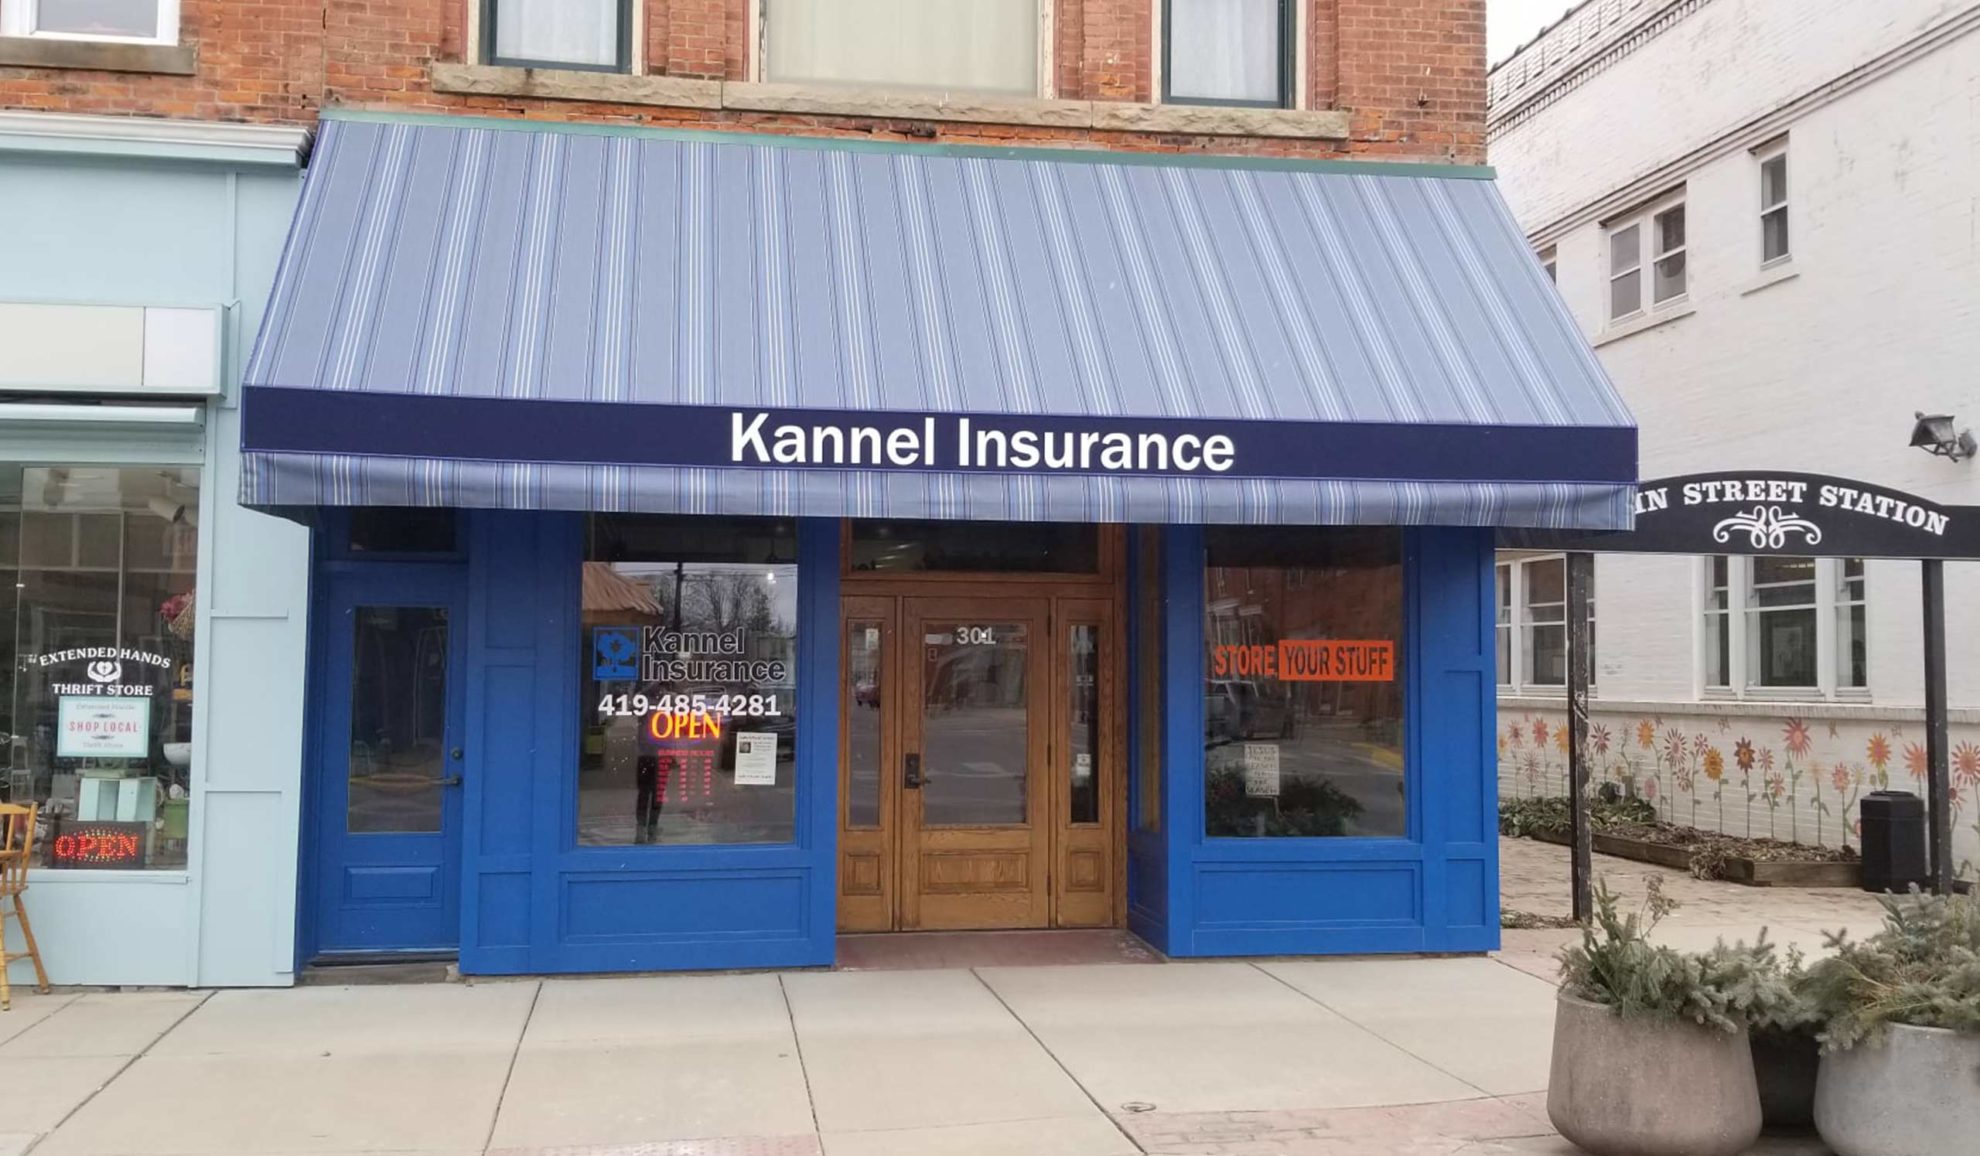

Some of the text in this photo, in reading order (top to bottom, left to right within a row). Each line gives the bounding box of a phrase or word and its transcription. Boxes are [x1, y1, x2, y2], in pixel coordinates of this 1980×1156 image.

[731, 412, 1235, 472] Kannel Insurance
[1635, 480, 1949, 536] IN STREET STATION
[643, 626, 745, 654] Kannel
[956, 627, 996, 645] 301
[39, 647, 171, 669] EXTENDED HANDS
[642, 654, 786, 681] Insurance
[1215, 645, 1388, 676] STORE YOUR STUFF
[52, 684, 153, 696] THRIFT STORE
[598, 694, 781, 717] 419-485-4281
[69, 721, 138, 732] SHOP LOCAL
[651, 710, 722, 739] OPEN
[54, 833, 138, 858] OPEN
